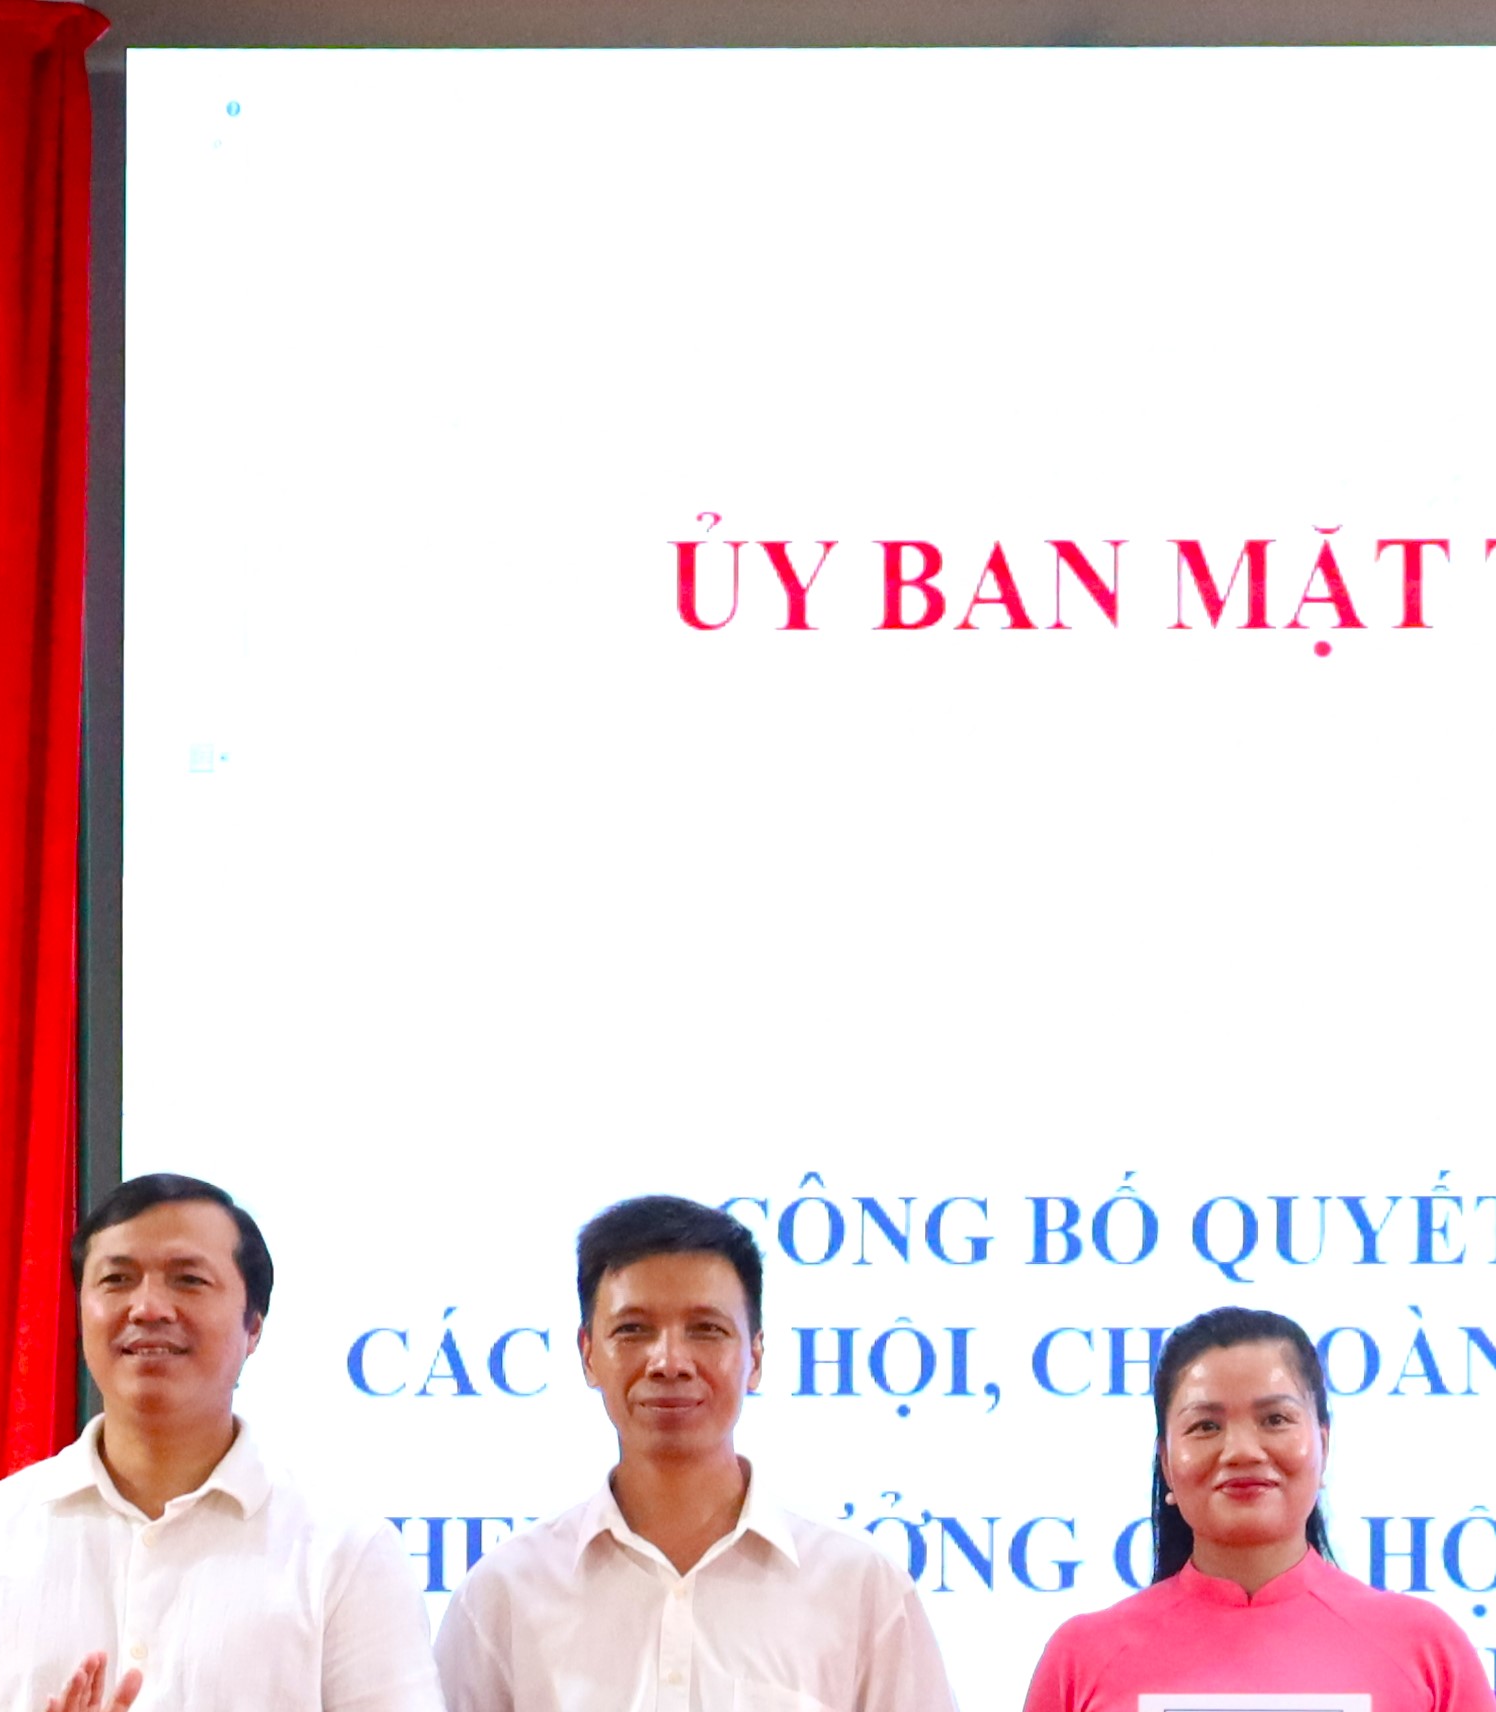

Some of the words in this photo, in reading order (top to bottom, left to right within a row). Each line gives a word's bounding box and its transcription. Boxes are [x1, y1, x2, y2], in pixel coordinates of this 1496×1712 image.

[670, 510, 842, 632] ỦY
[872, 537, 1130, 632] BAN
[1167, 526, 1455, 659] MẶT
[1027, 1170, 1159, 1265] BỐ
[347, 1306, 549, 1396] CÁC
[792, 1317, 1001, 1418] HỘI,
